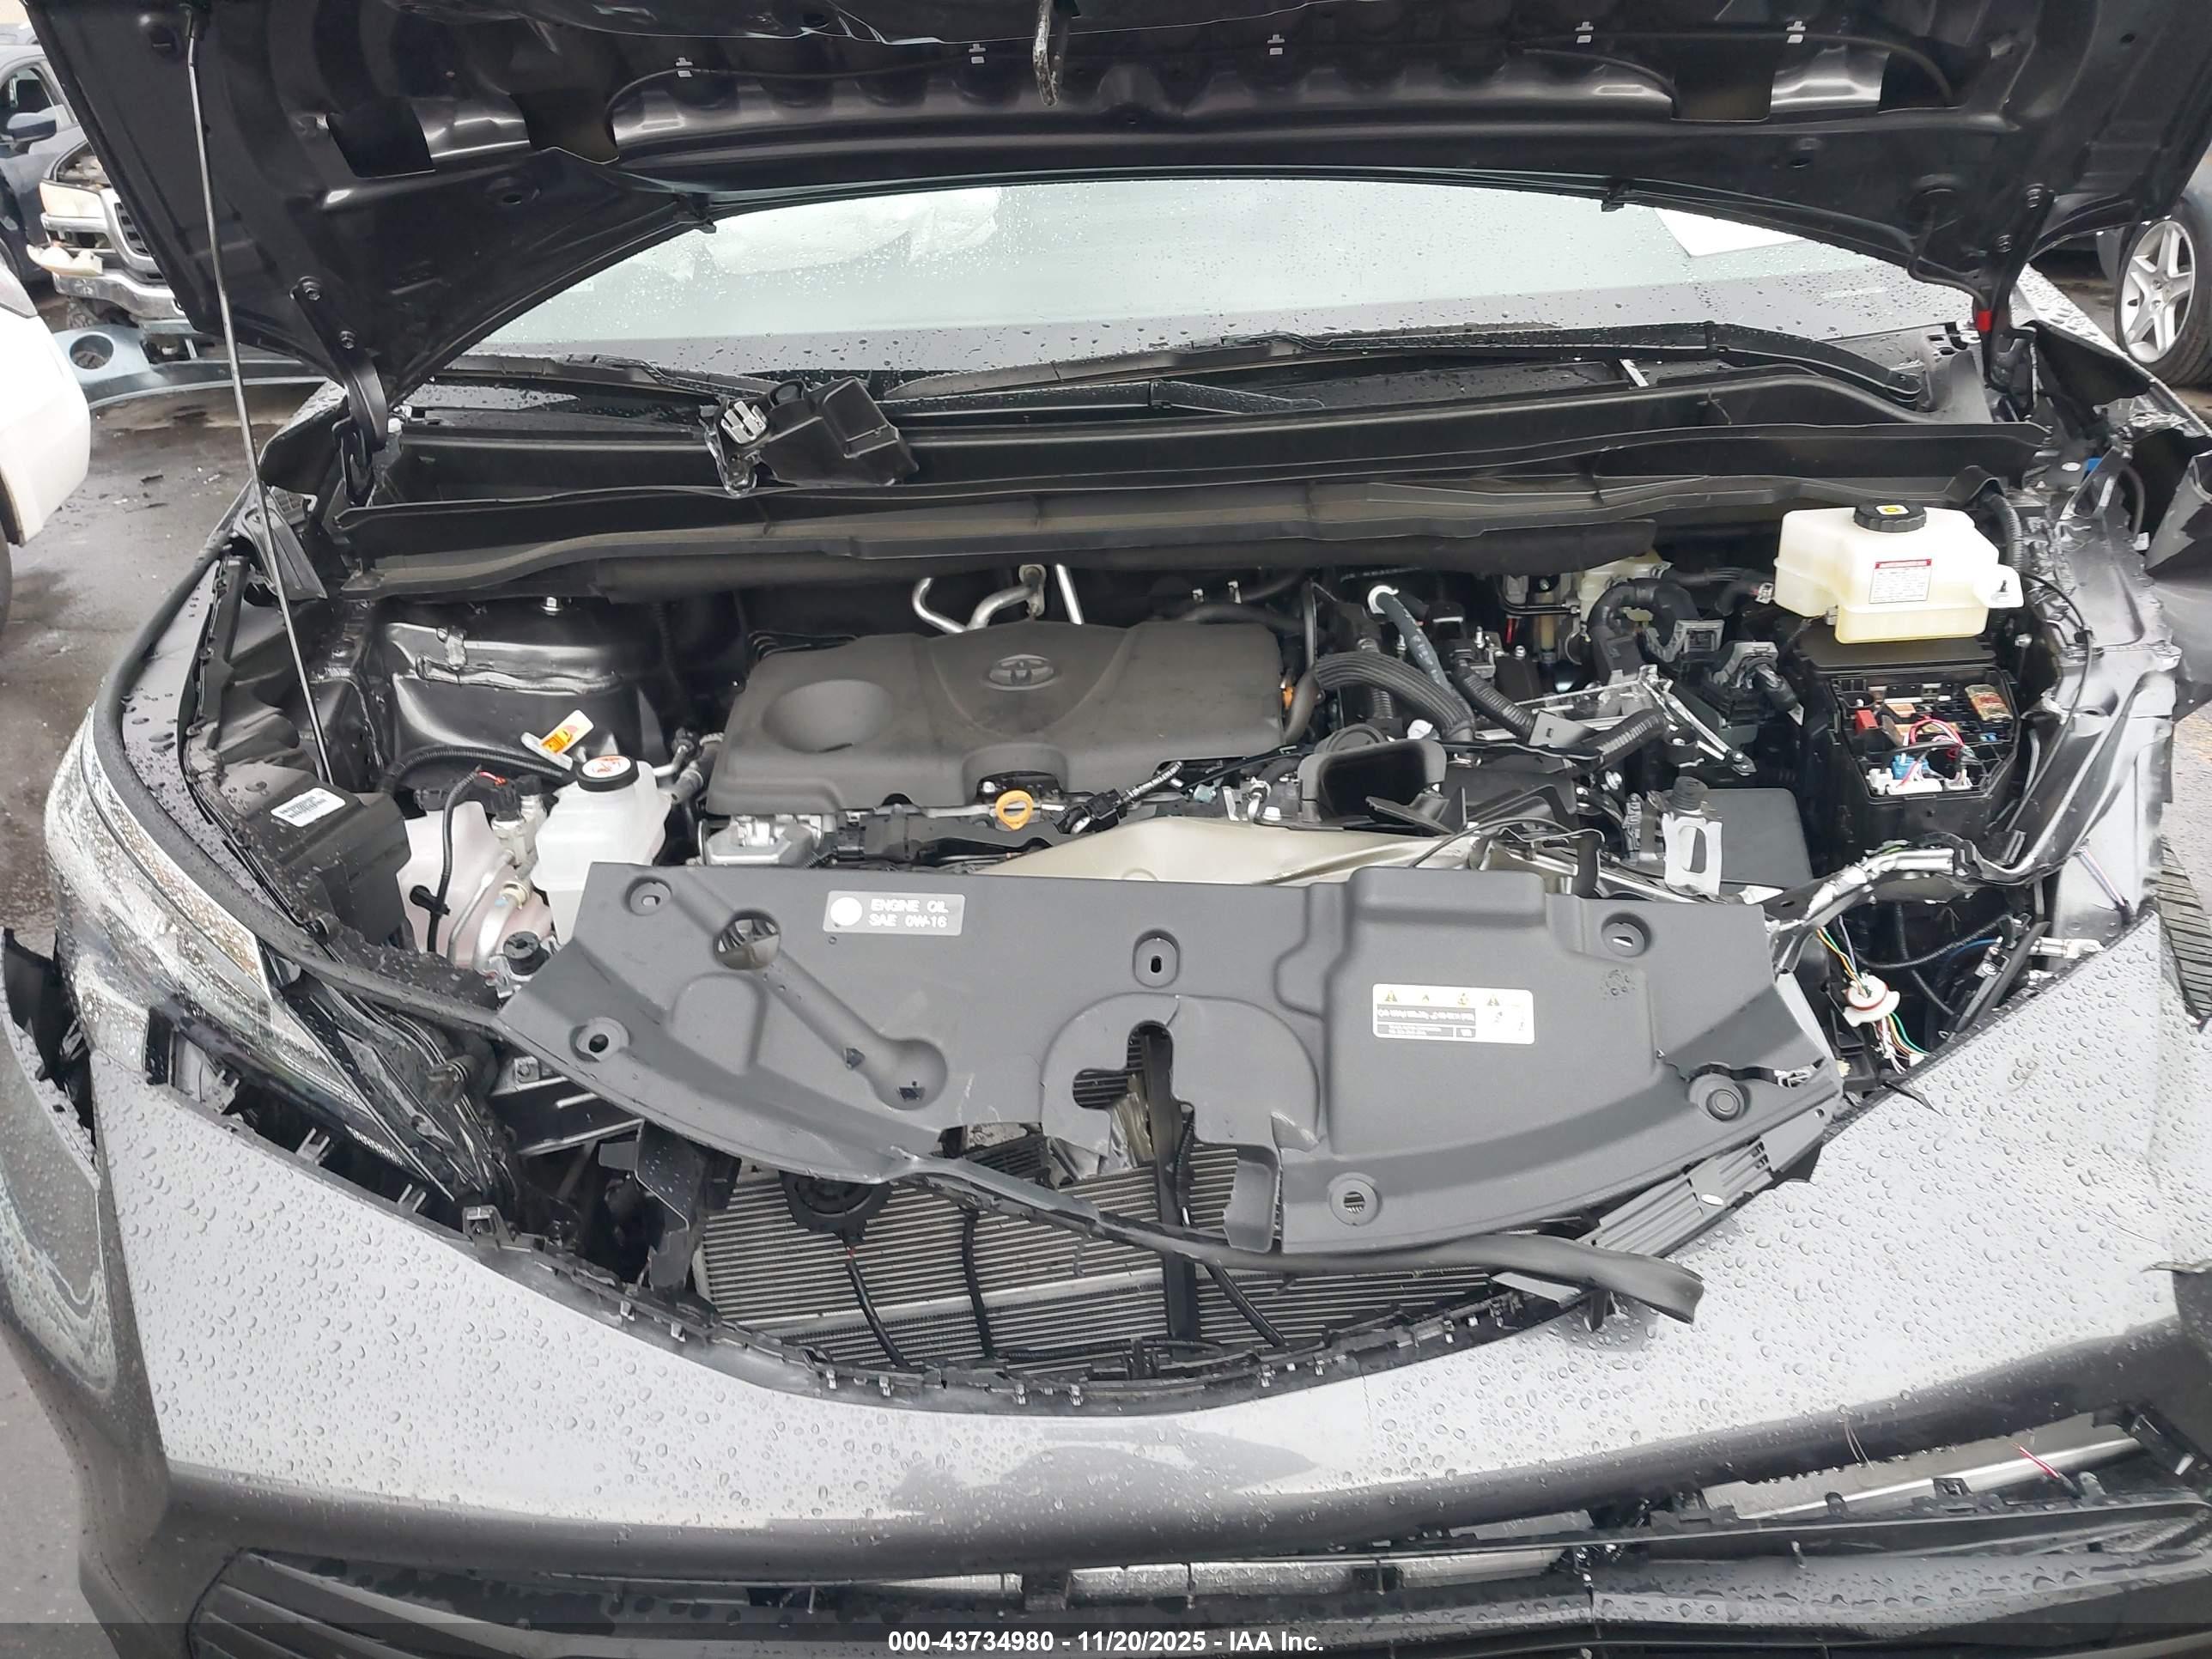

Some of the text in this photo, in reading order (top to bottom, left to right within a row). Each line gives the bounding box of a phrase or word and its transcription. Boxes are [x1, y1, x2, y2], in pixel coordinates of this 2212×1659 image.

[871, 898, 949, 913] ENGINE OIL
[868, 913, 947, 928] SAE 0W-16
